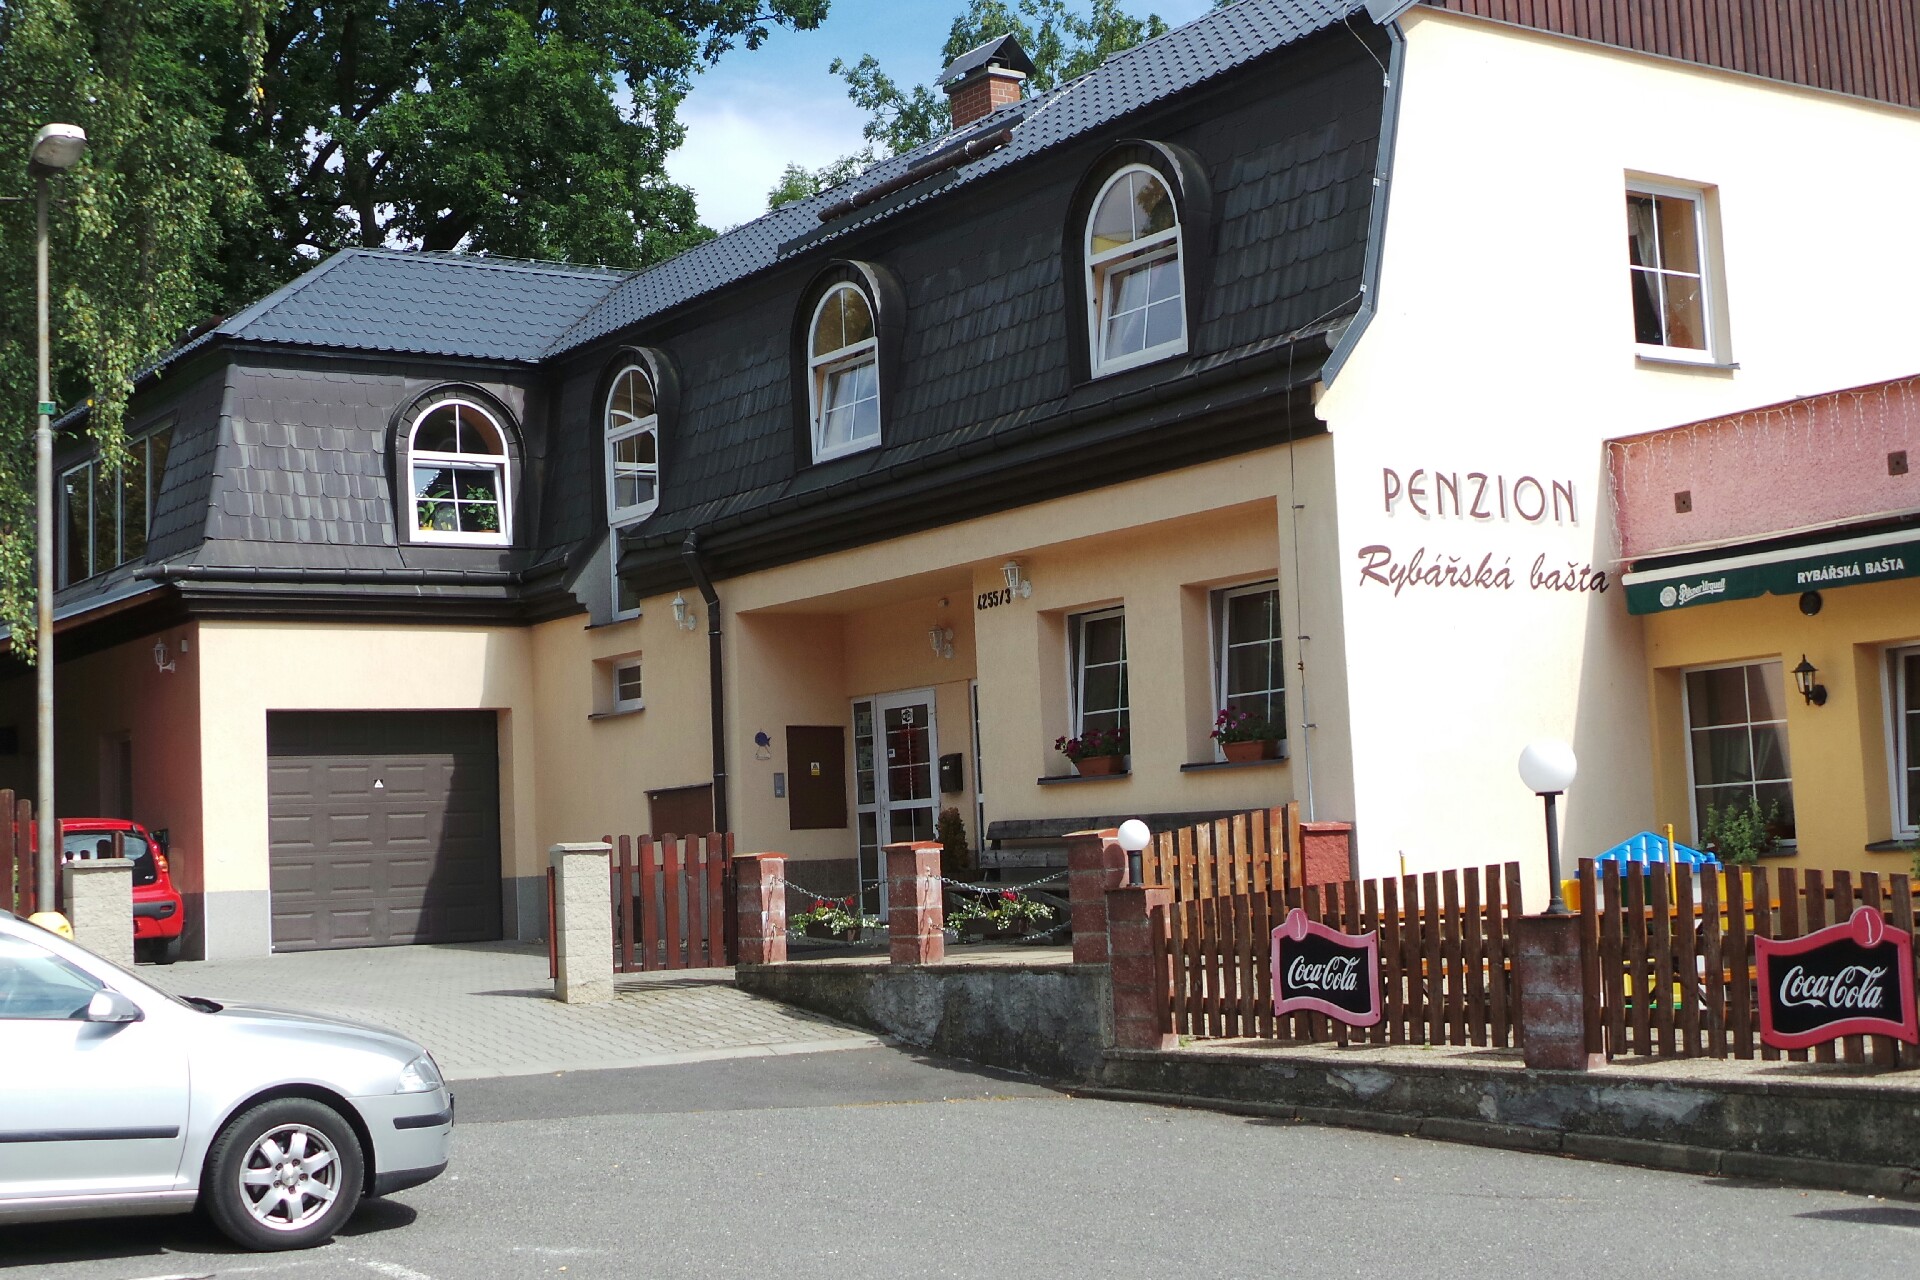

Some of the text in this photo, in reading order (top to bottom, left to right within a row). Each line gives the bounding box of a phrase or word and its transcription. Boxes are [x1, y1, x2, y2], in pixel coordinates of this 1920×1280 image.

[1383, 468, 1576, 523] PENZION
[1358, 545, 1610, 598] Rybářská bašta
[1797, 557, 1904, 584] RYBÁŘSKÁ BAŠTA
[977, 588, 1011, 610] 4255/3
[1287, 955, 1361, 991] Coca-Cola
[1779, 965, 1888, 1009] Coca-Cola
